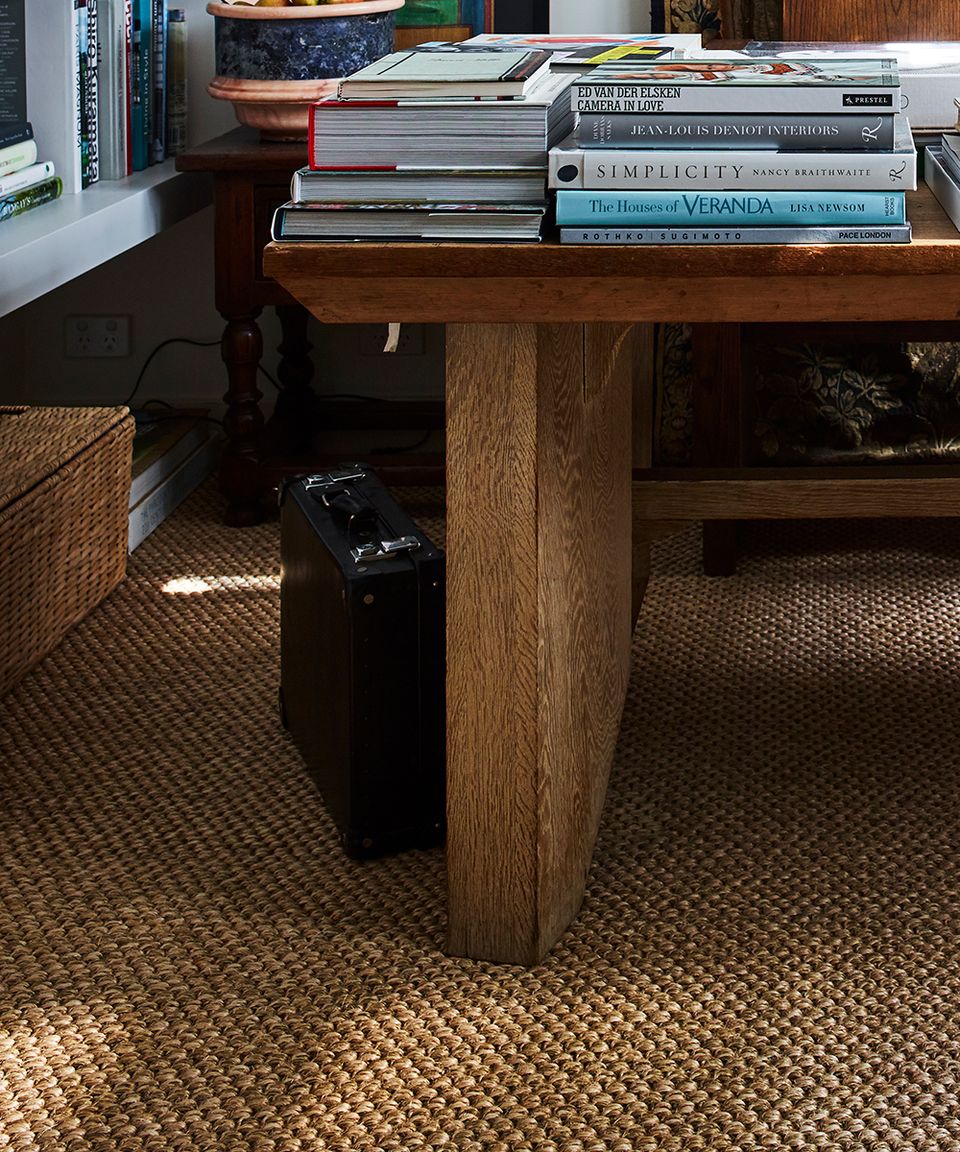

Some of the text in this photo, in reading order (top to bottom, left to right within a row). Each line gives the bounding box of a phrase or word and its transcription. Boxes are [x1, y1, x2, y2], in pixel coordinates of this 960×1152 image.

[577, 87, 681, 98] ED VAN DER ELSKEN
[854, 96, 888, 104] PRESTEL
[577, 100, 664, 112] CAMERA IN LOVE
[89, 66, 98, 183] Kuramata
[630, 125, 839, 136] JEAN-LOUIS DENIOT INTERIORS
[597, 164, 871, 180] SIMPLICITY NANCY BRAITHWAITE
[589, 194, 866, 217] The Houses of VERANDA LISA NEWSOM
[583, 233, 644, 241] ROTHKO
[660, 233, 742, 241] SUGIMOTO
